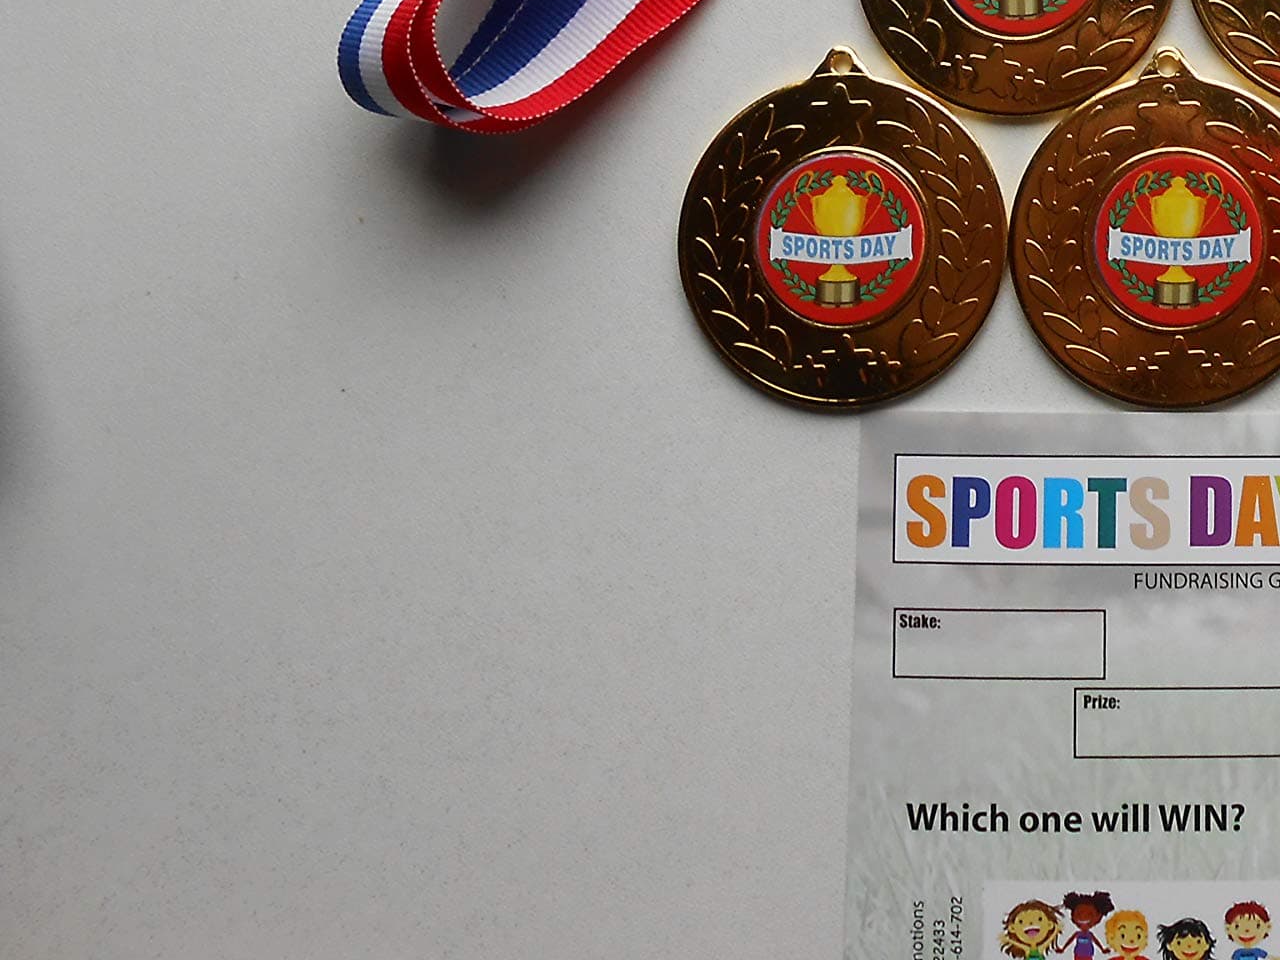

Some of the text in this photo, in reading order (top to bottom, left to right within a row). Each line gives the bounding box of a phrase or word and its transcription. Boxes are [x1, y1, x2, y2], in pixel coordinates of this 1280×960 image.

[782, 235, 897, 260] SPORTS DAY
[1120, 235, 1236, 261] SPORTS DAY
[906, 474, 1170, 550] SPORTS
[1133, 572, 1263, 590] FUNDRAISING
[899, 614, 941, 630] Stake:
[1083, 694, 1121, 711] Prize:
[906, 803, 1246, 833] Which one will WIN?
